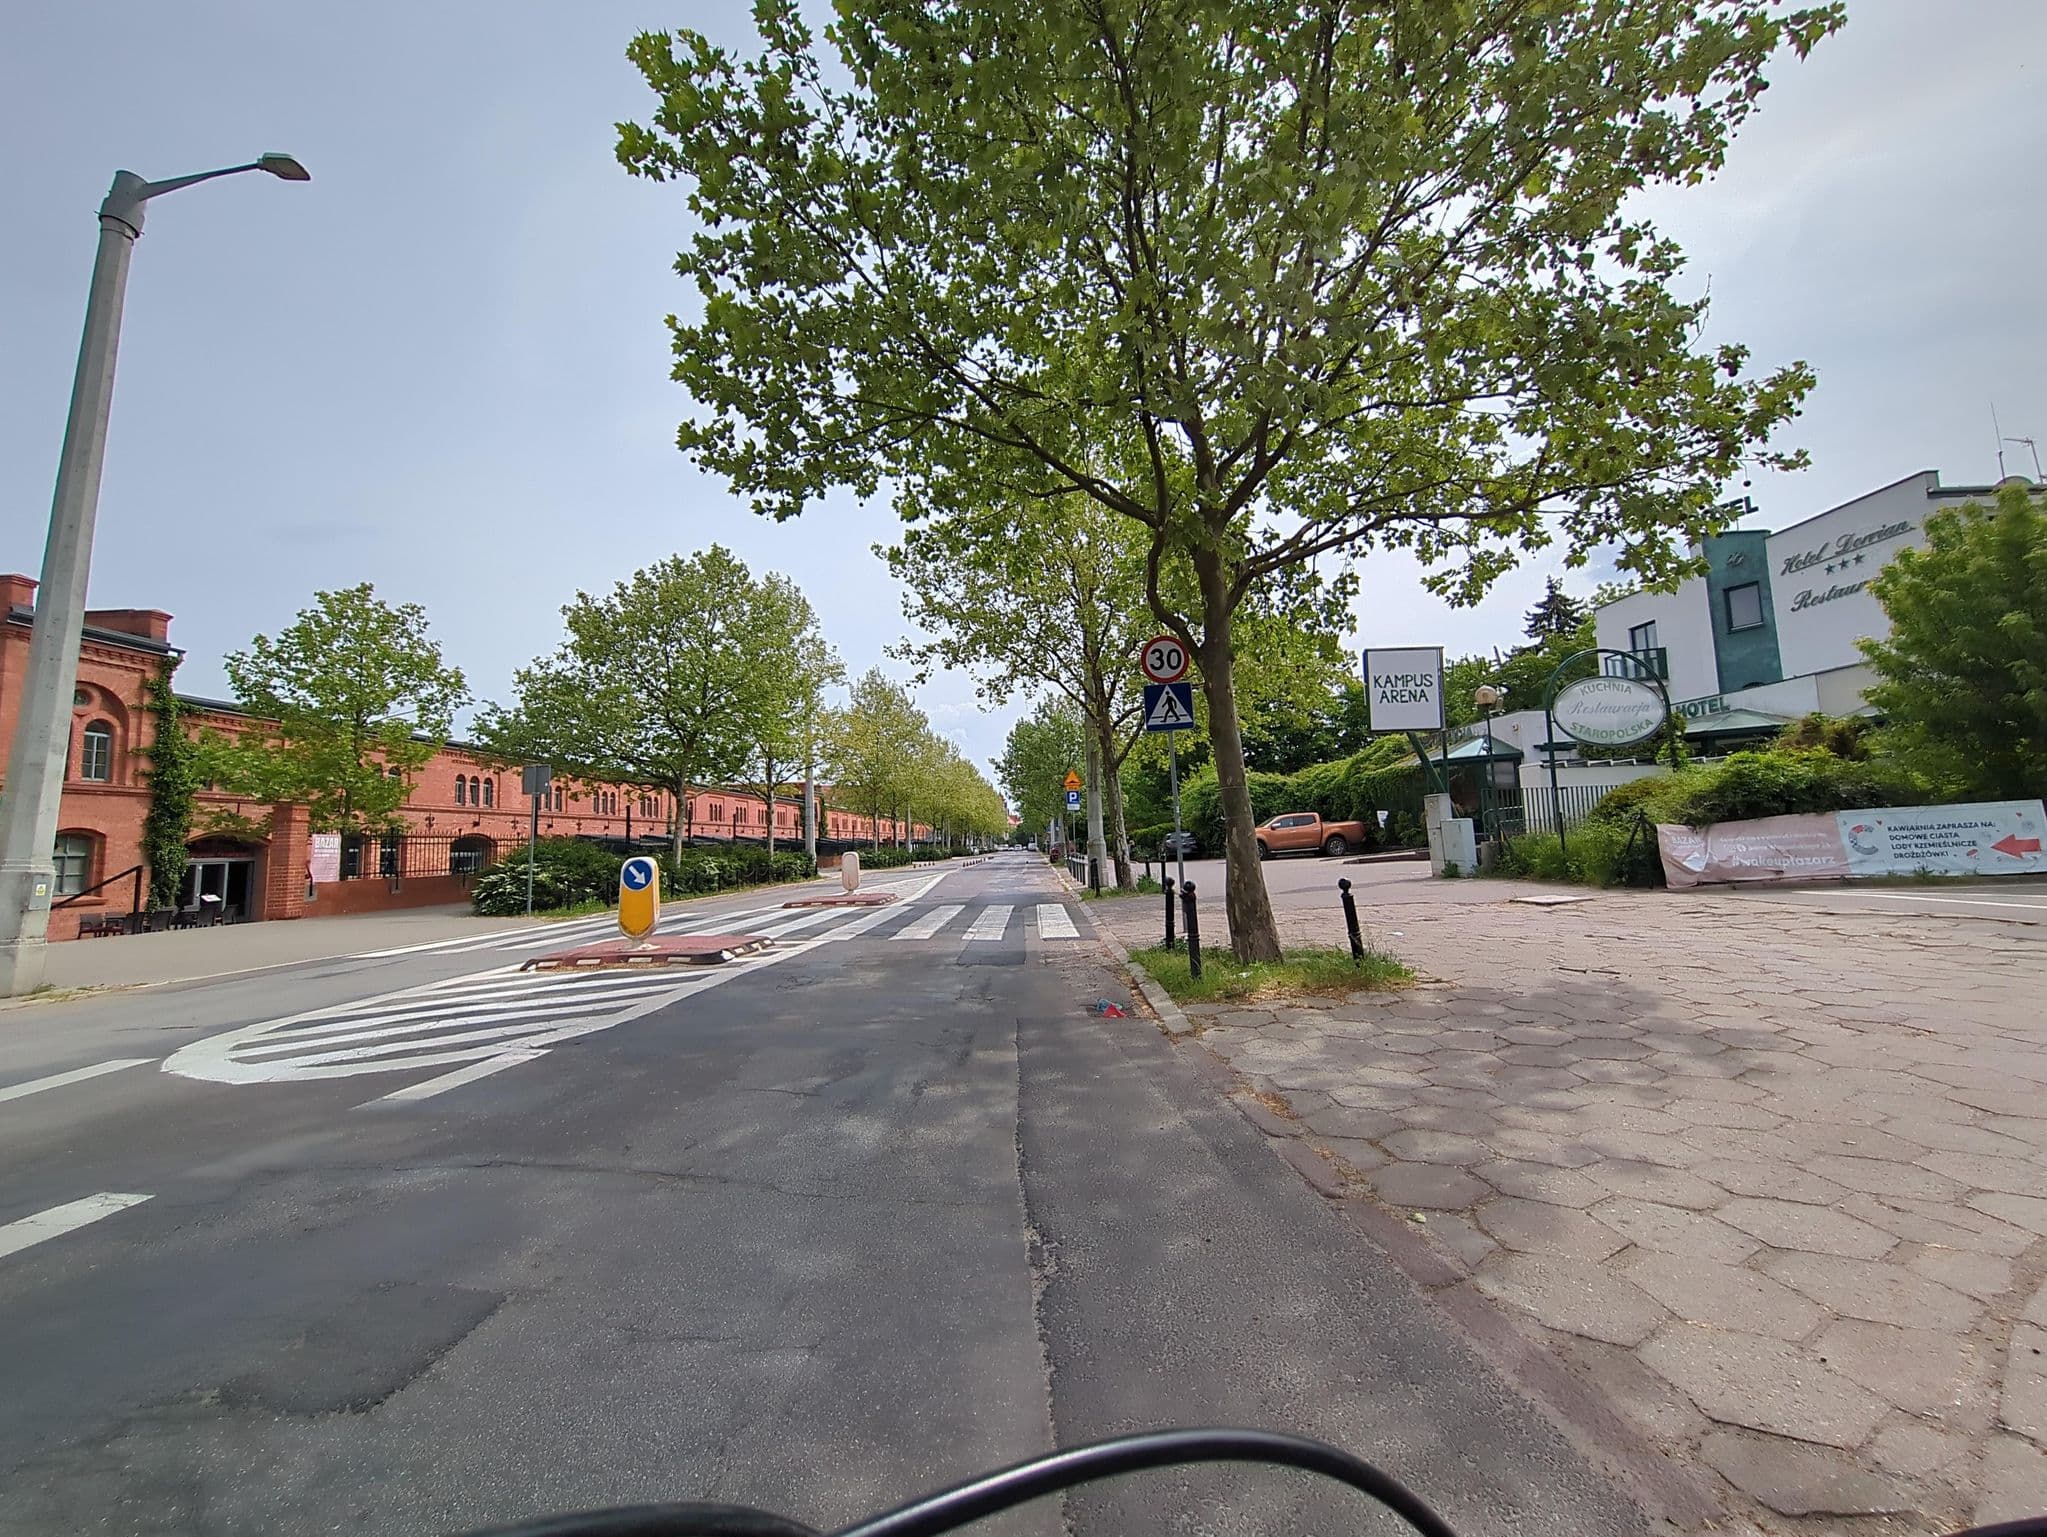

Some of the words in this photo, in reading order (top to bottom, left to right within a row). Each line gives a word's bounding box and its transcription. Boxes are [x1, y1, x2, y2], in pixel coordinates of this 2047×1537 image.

[1781, 542, 1829, 576] Hotel
[1150, 648, 1182, 671] 30
[1373, 673, 1434, 689] KAMPUS
[1579, 682, 1633, 696] KUCHNIA
[1379, 688, 1429, 704] ARENA
[1567, 700, 1651, 717] Restauracja
[1675, 697, 1731, 718] HOTEL
[1569, 719, 1655, 740] STAROPOLSKA
[1069, 791, 1078, 803] P
[1887, 824, 1936, 833] KAWIARNIA
[1936, 822, 1979, 830] ZAPRASZA
[1980, 821, 1996, 829] NA:
[1889, 833, 1928, 841] DOMOWE
[1891, 842, 1914, 850] LODY
[1914, 839, 1977, 849] RZEMIEŚLNICZE
